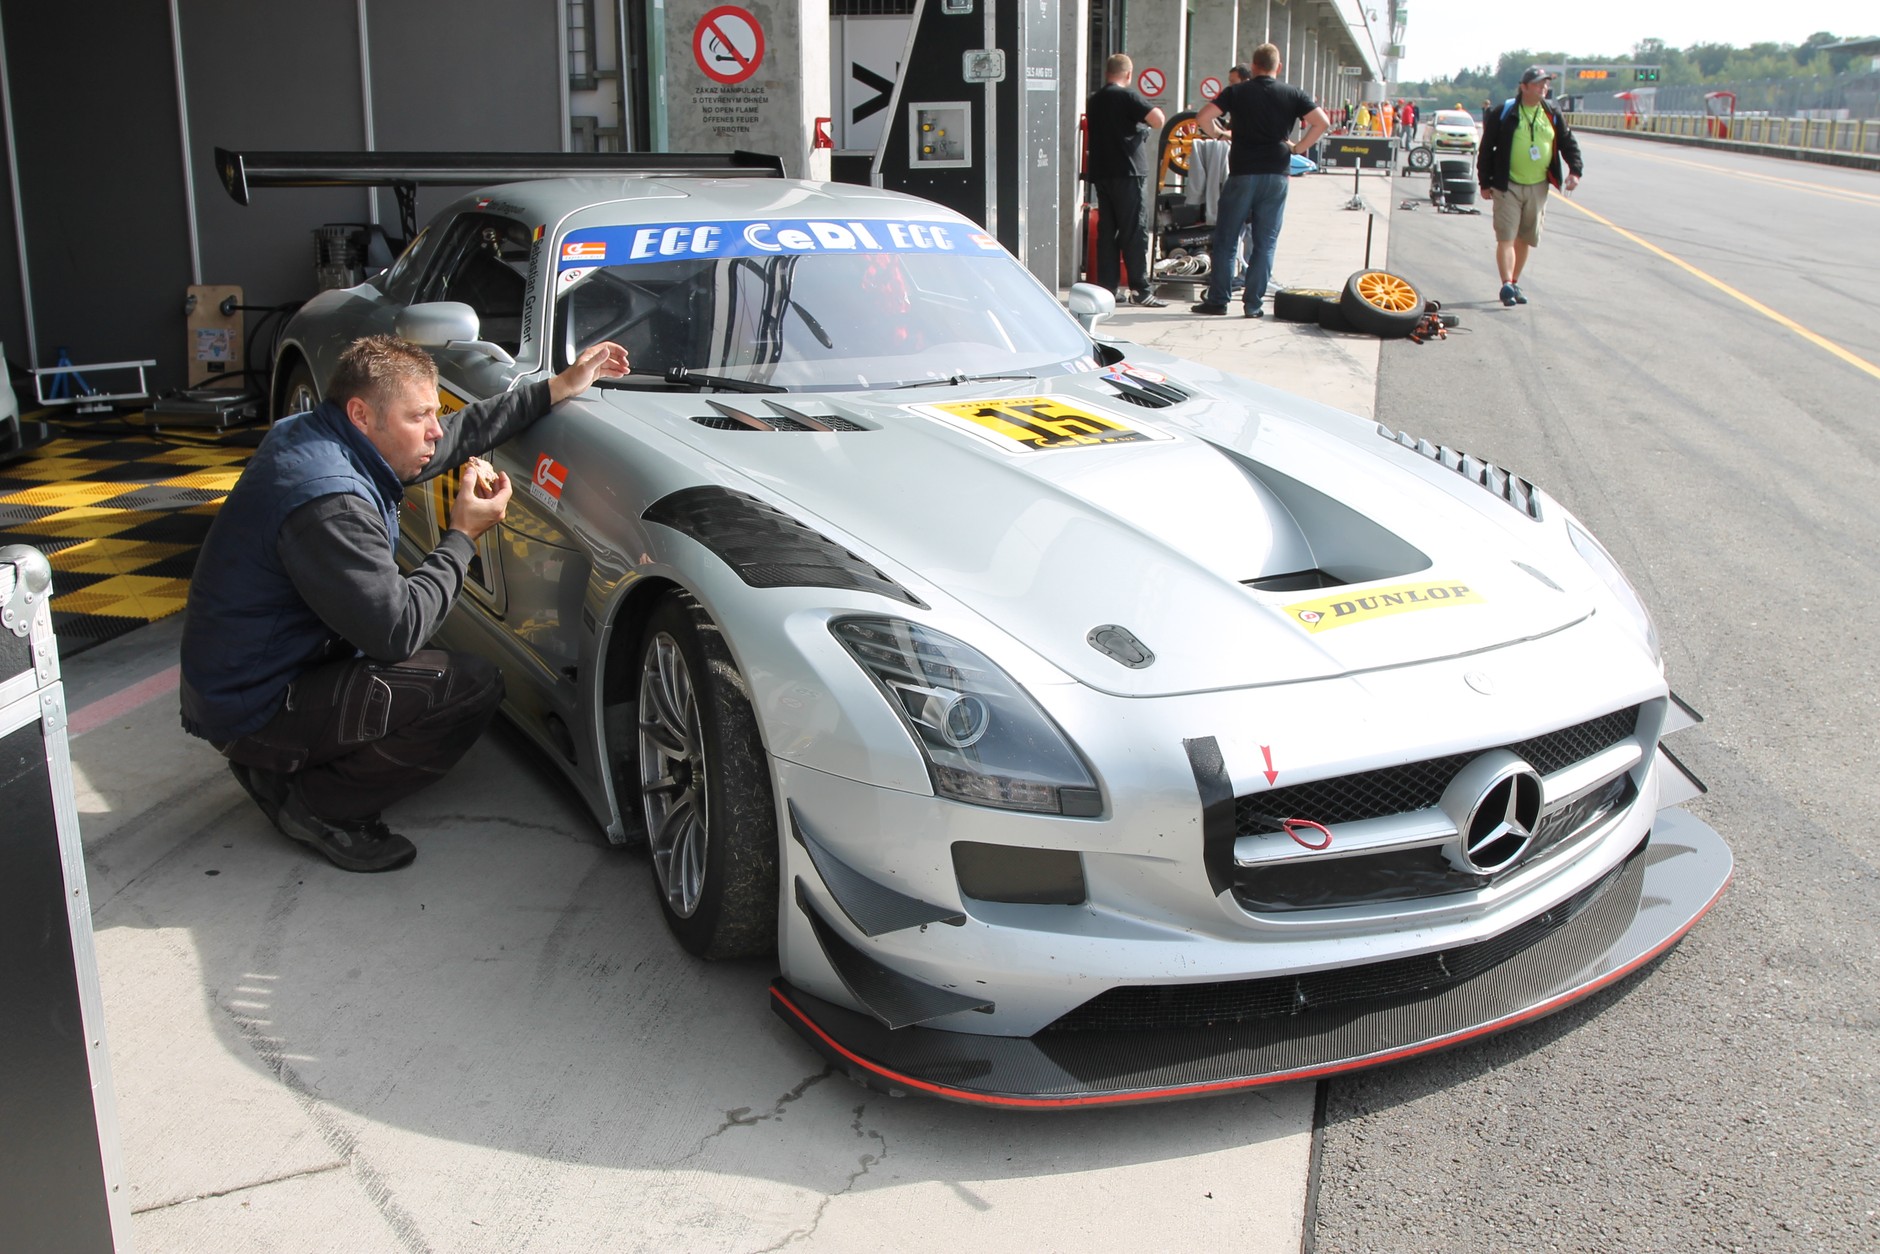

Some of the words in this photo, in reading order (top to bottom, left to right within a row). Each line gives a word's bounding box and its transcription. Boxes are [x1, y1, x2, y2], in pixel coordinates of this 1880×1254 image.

[629, 226, 722, 260] ECC
[886, 223, 955, 250] ECC
[526, 239, 544, 294] Sebastian
[522, 295, 537, 344] Grunert
[972, 403, 1117, 440] 15
[1329, 585, 1470, 617] DUNLOP
